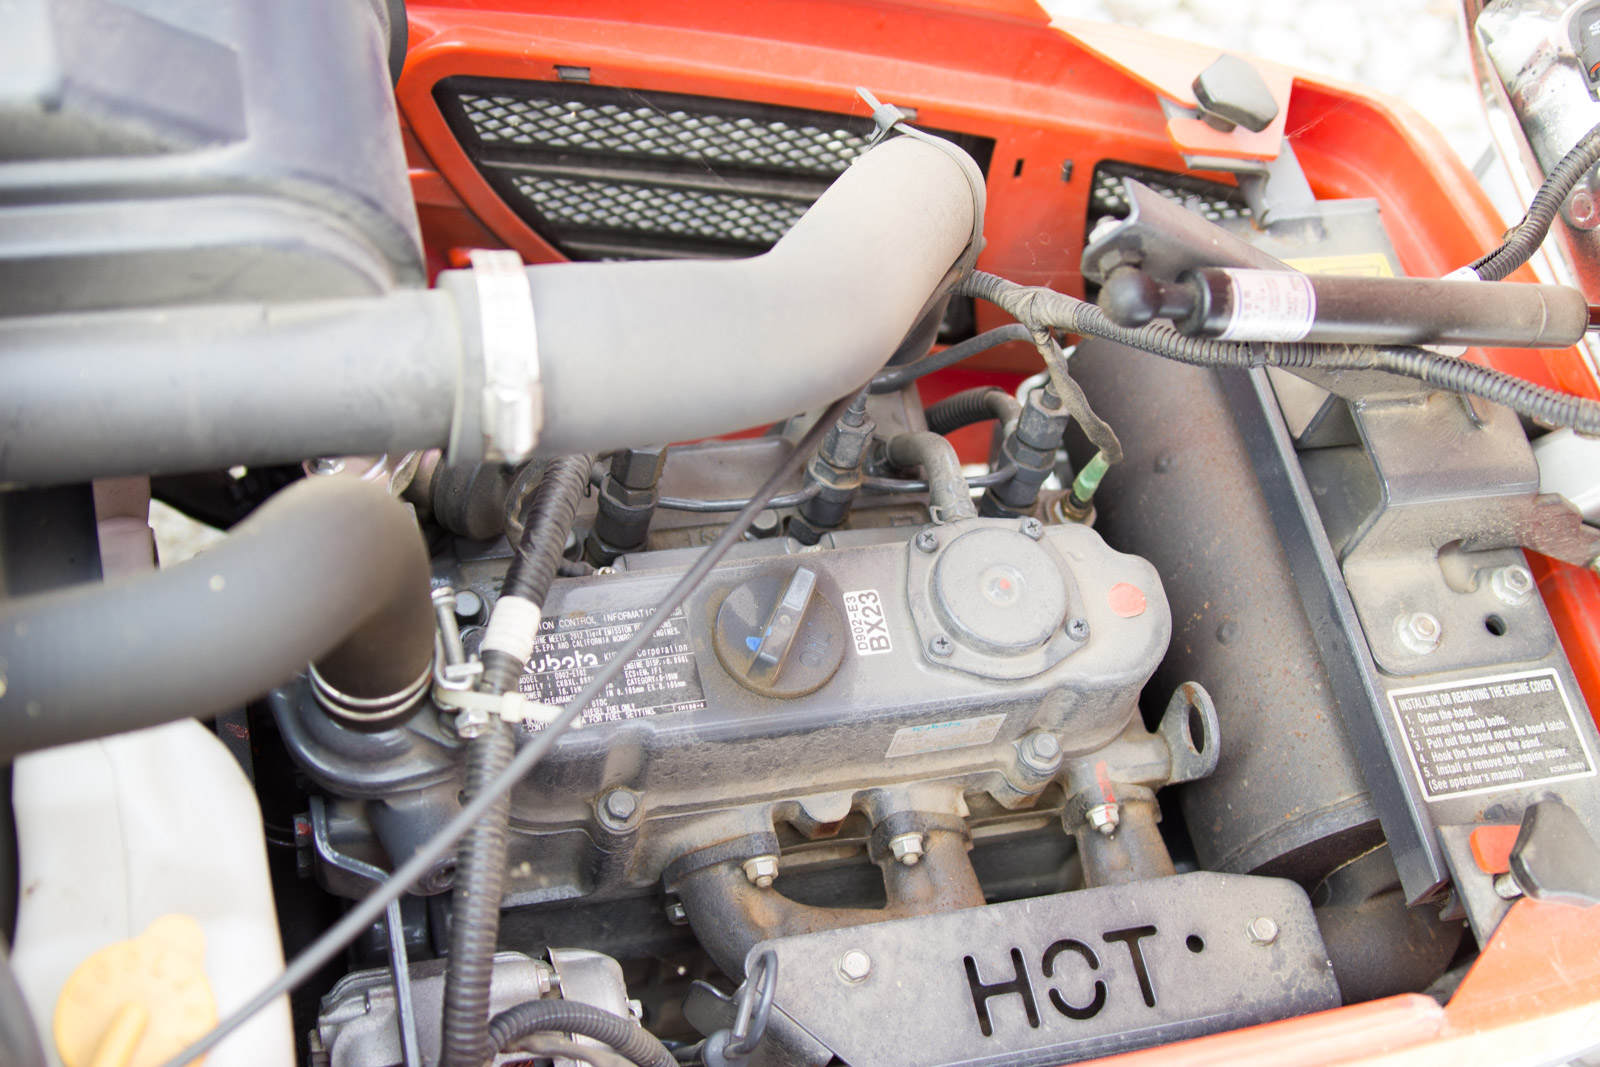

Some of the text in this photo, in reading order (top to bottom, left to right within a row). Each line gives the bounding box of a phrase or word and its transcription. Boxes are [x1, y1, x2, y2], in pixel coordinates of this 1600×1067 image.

[558, 616, 597, 628] CONTROL
[603, 608, 656, 622] INFORMATIO
[845, 596, 869, 651] D902-E3
[858, 591, 891, 652] BX23
[558, 641, 569, 650] AND
[572, 636, 610, 648] CALIFORNIA
[570, 631, 584, 640] 2012
[603, 625, 632, 636] EMISSION
[636, 643, 688, 658] Corporation
[519, 682, 544, 693] FAMILY
[525, 690, 542, 700] OWER
[1398, 679, 1555, 711] INSTALLING OR REMOVING THE ENGINE COVER
[1404, 706, 1477, 725] 1. Open the hood.
[1409, 715, 1509, 739] 2. Loosen the knob bolts.
[1414, 719, 1569, 752] 3. Pull out the band near the hood latch.
[1419, 753, 1429, 764] 4.
[1431, 750, 1454, 763] Hook
[1452, 748, 1467, 760] the
[1466, 744, 1488, 757] hood
[1487, 742, 1507, 754] with
[1505, 740, 1520, 752] the
[1423, 747, 1569, 778] 5. Install or remove the engine cover.
[1428, 765, 1524, 793] (See operator's manual)
[963, 924, 1158, 1038] HOT
